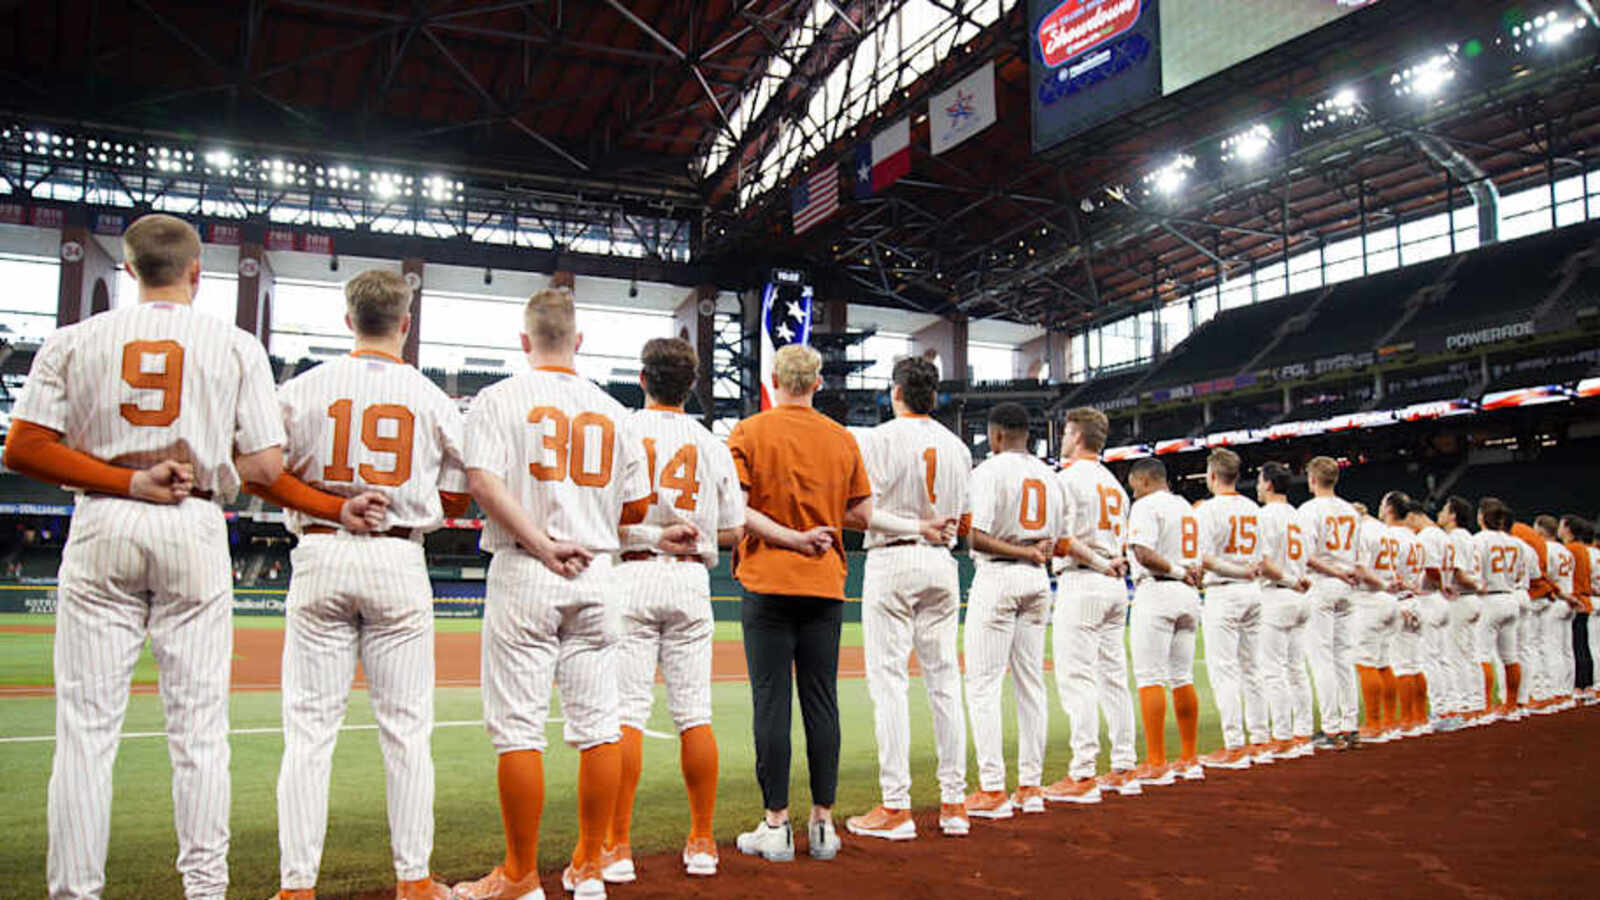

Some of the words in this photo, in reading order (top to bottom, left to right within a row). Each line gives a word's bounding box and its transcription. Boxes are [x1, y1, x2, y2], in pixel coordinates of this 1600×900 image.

[1046, 0, 1135, 54] Showdown
[1446, 320, 1536, 348] POWERADE
[120, 340, 184, 427] 9
[323, 399, 414, 487] 19
[528, 407, 615, 488] 30
[642, 437, 699, 511] 14
[922, 448, 937, 504] 1
[1019, 478, 1046, 530] 0
[1181, 516, 1198, 559] 8
[1224, 515, 1257, 555] 15
[1287, 524, 1303, 561] 6
[1325, 515, 1356, 551] 37
[1490, 546, 1518, 574] 27
